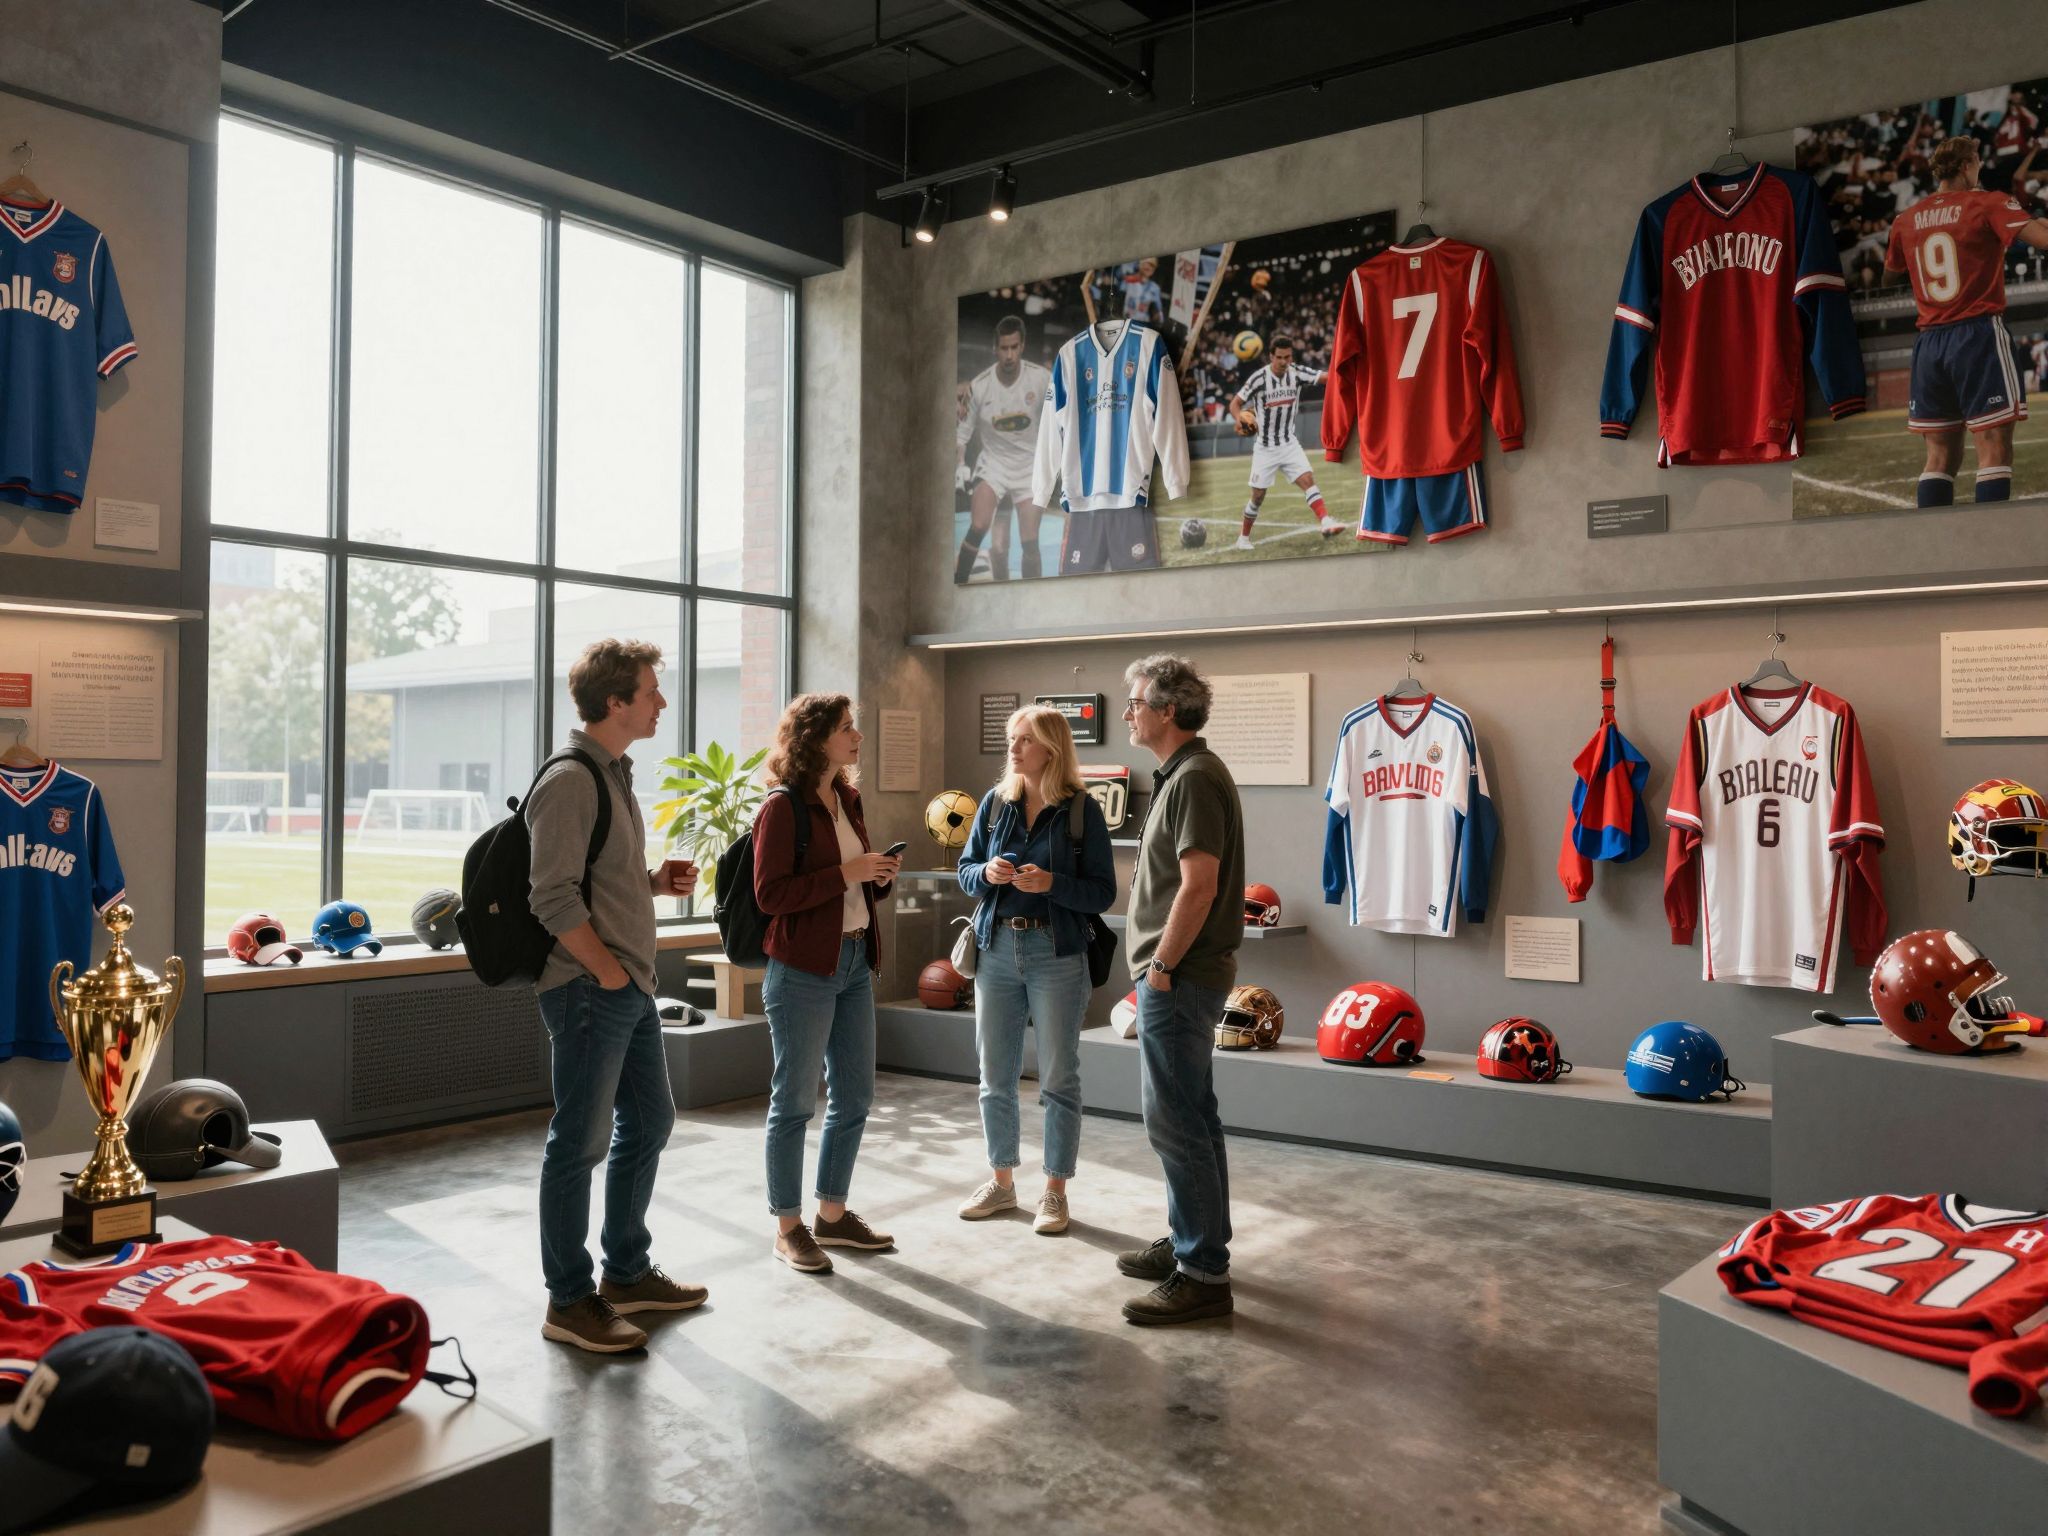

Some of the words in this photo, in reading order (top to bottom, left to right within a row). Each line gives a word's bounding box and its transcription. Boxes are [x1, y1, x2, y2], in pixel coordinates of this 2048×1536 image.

[1392, 292, 1438, 380] 7
[1757, 798, 1780, 848] 6
[1811, 1228, 2018, 1308] 21
